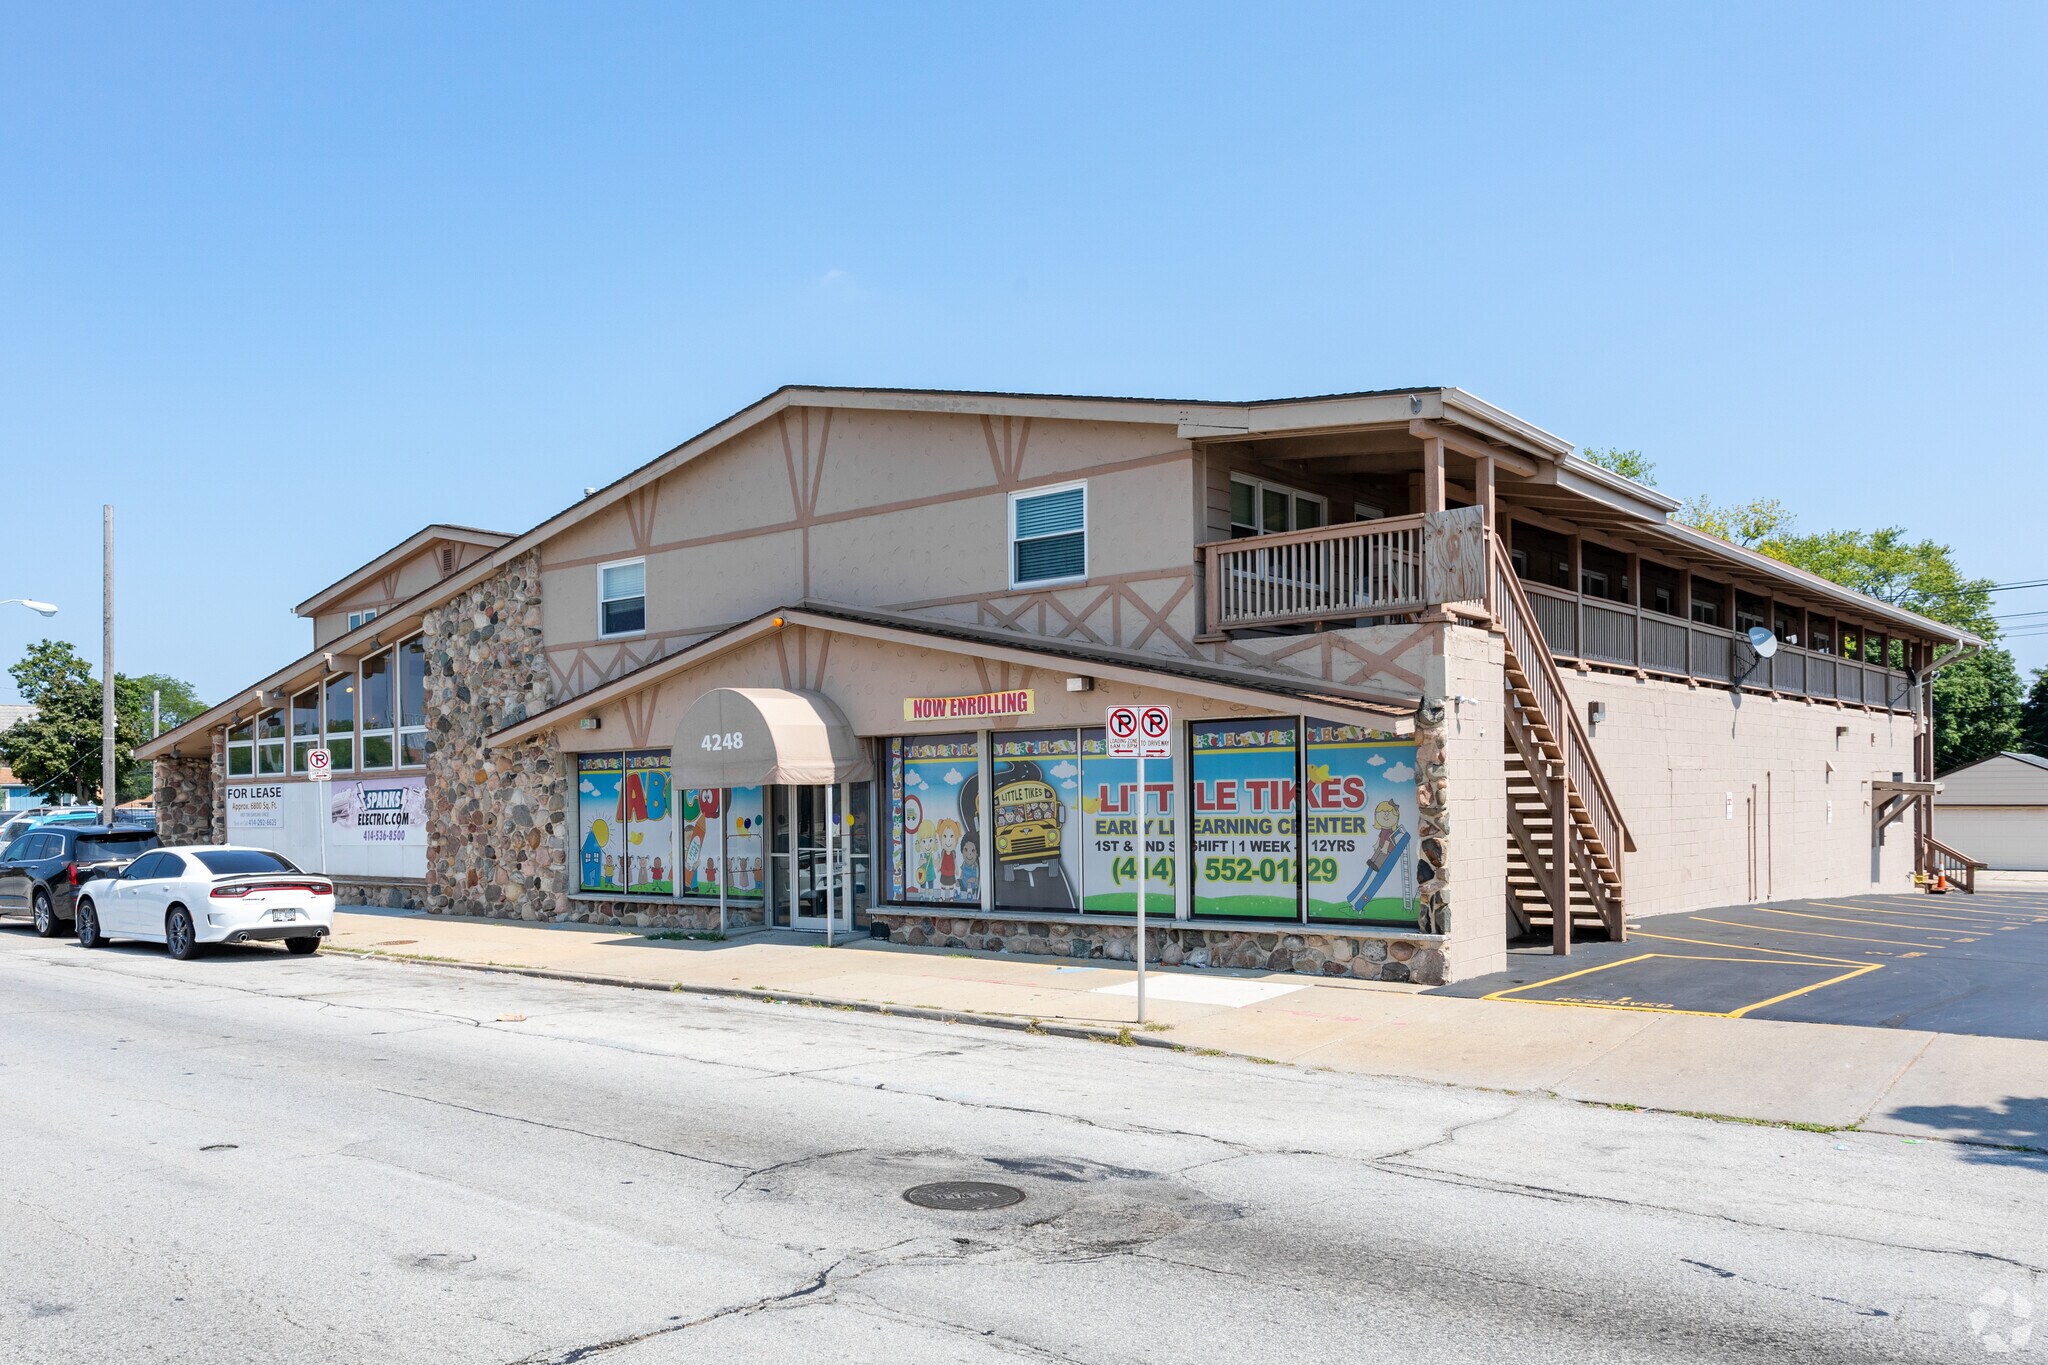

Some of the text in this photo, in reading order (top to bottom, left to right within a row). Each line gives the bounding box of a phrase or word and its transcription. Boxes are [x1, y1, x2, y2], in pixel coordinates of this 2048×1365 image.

[913, 691, 1028, 718] NOW ENROLLING
[701, 731, 744, 751] 4248
[227, 787, 282, 799] FOR LEASE
[366, 791, 401, 809] SPARKS
[1001, 787, 1043, 801] LITTLE TIKES
[1246, 777, 1366, 814] TIKES
[232, 802, 250, 811] Approx.
[251, 802, 262, 810] 6800
[357, 812, 409, 826] ELECTRIC.COM
[1095, 816, 1366, 835] EARLY LEARNING CENTER
[363, 829, 406, 841] 414-536-8500
[1095, 840, 1119, 852] 1ST
[1123, 840, 1133, 852] &
[1144, 840, 1165, 852] ND
[1168, 840, 1229, 852] SHIFT
[1239, 840, 1246, 852] 1
[1249, 840, 1291, 852] WEEK
[1311, 839, 1356, 852] 12YRS
[1205, 857, 1338, 883] 552-0129
